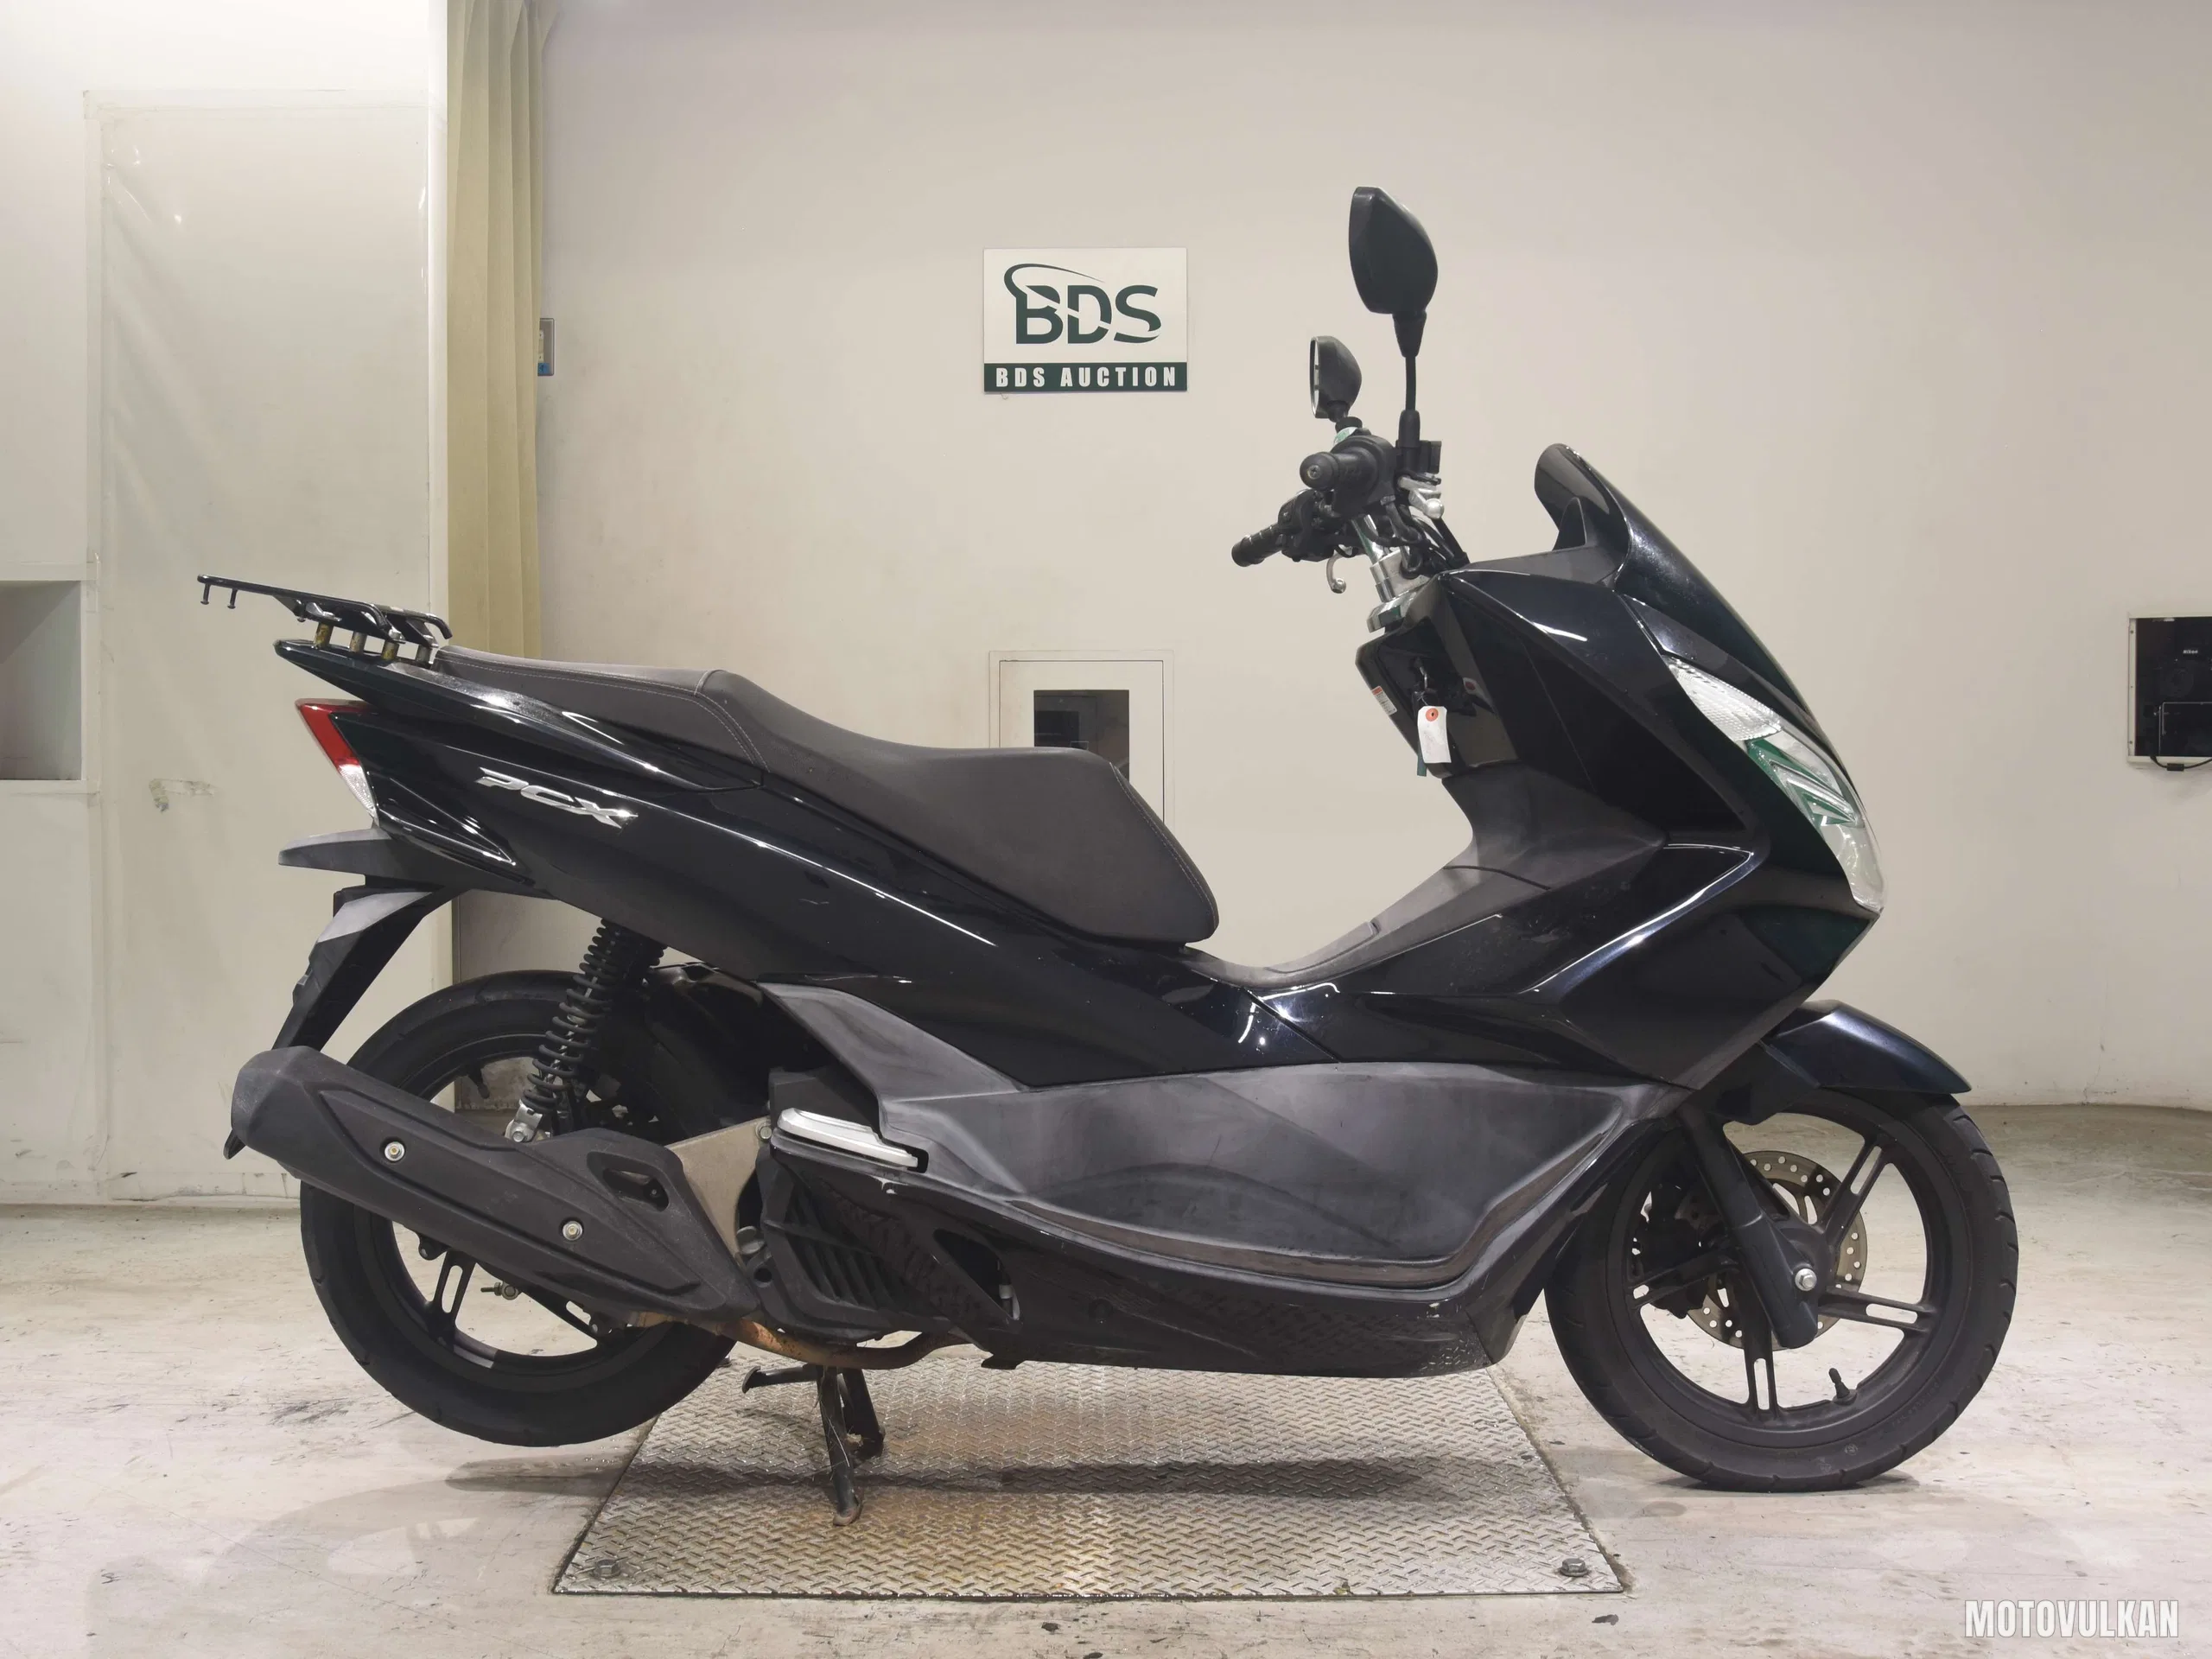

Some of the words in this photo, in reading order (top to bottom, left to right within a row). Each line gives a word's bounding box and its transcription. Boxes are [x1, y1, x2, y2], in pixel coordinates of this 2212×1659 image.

[1004, 263, 1161, 344] BDS
[995, 366, 1046, 387] BDS
[1059, 365, 1176, 387] AUCTION
[474, 766, 639, 829] PCX
